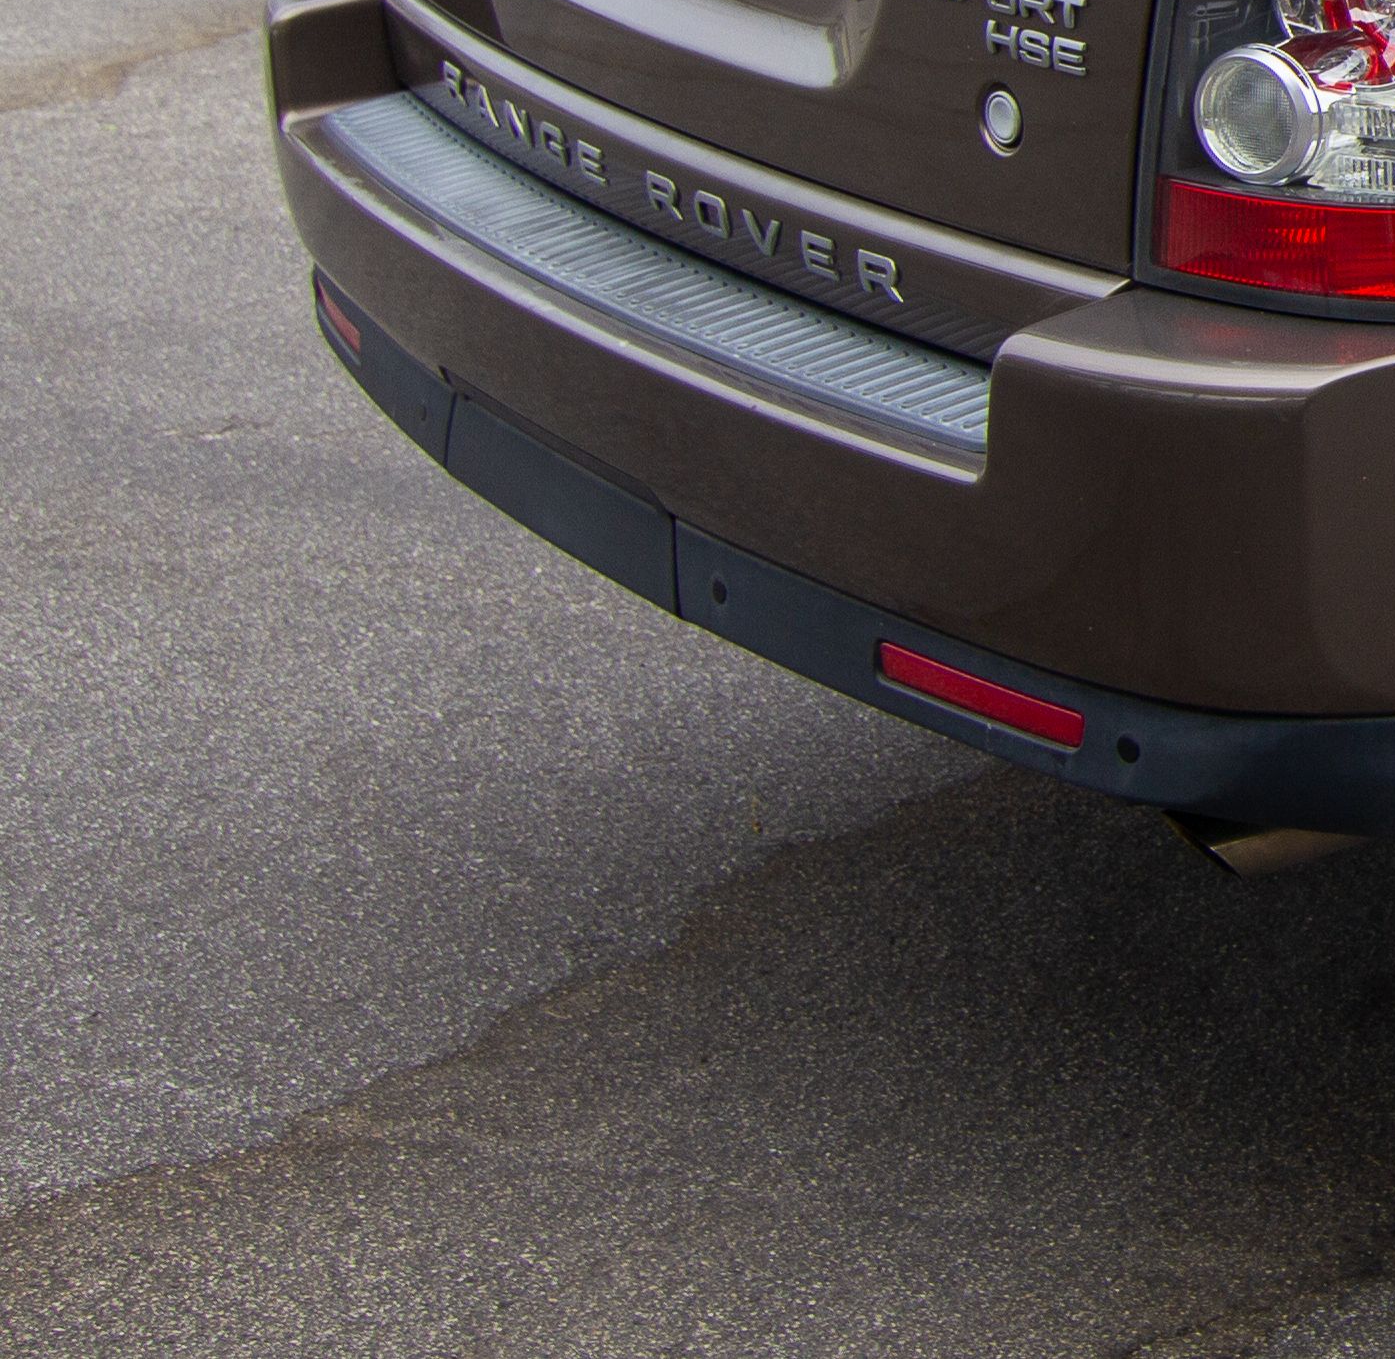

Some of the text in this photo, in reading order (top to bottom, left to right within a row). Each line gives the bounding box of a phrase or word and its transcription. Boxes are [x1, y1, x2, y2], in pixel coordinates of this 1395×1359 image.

[985, 19, 1087, 76] HSE
[442, 60, 904, 303] RANGE ROVER
